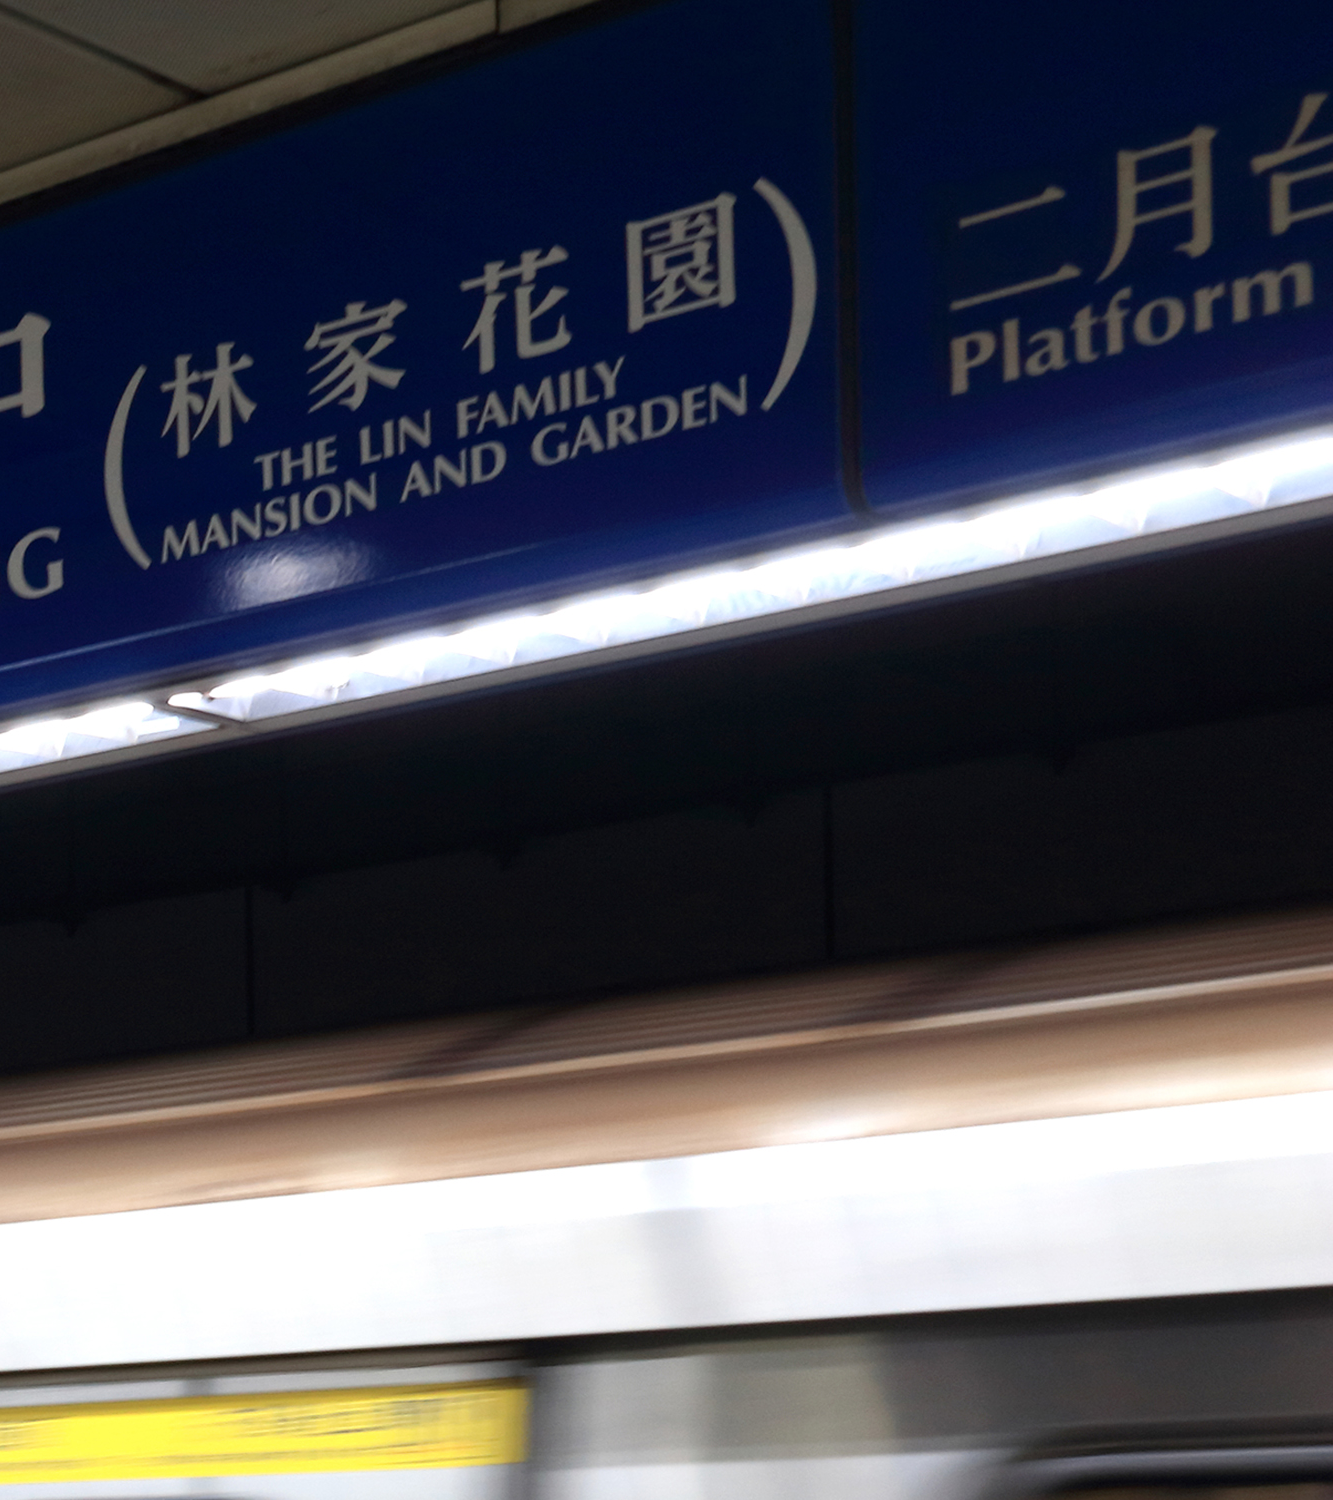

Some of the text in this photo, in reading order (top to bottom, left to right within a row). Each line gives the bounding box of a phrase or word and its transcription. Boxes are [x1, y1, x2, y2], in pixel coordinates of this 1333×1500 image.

[949, 92, 1333, 311] 二月台
[950, 261, 1314, 396] Platform
[159, 375, 749, 564] MANSION AND GARDEN
[254, 356, 626, 491] THE LIN FAMILY
